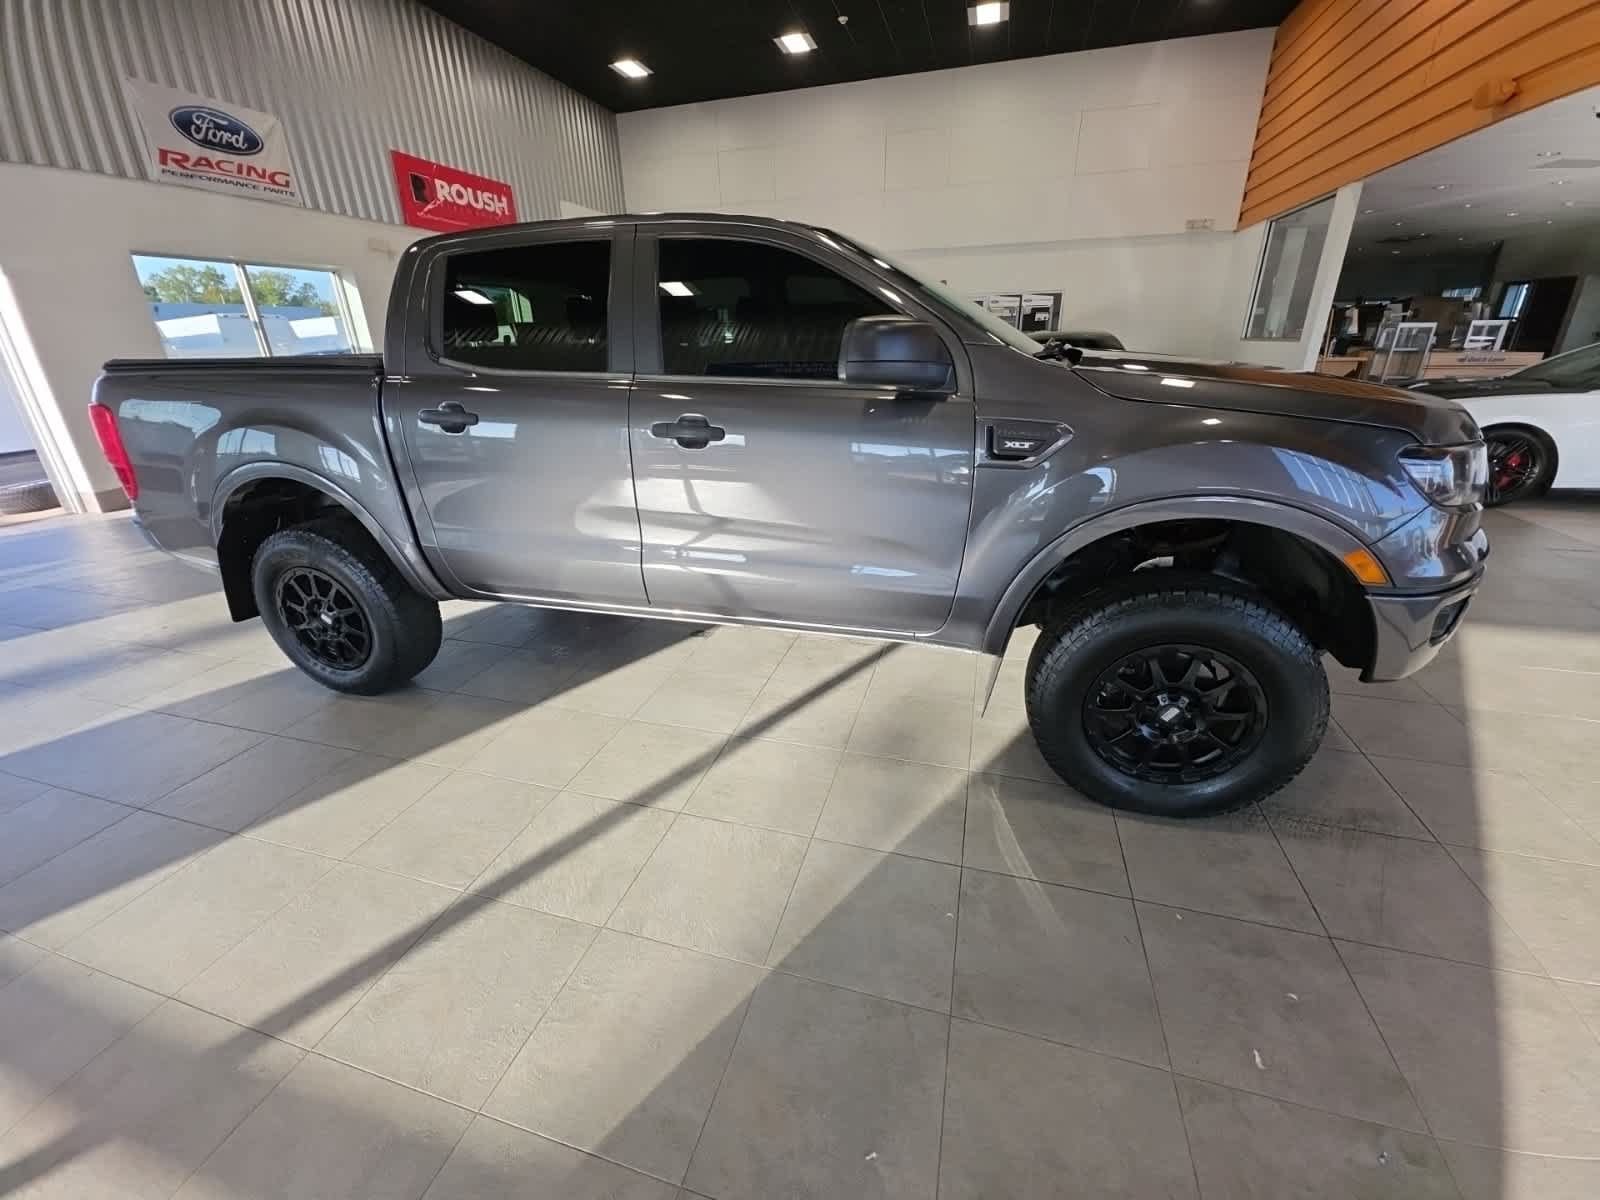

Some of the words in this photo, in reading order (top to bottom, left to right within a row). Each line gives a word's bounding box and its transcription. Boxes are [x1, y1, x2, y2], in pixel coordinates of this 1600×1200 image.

[190, 112, 248, 149] Ford
[158, 148, 290, 188] RACING
[161, 168, 260, 190] PERFORMANCE
[263, 186, 296, 197] PARTS
[434, 178, 509, 215] ROUSH
